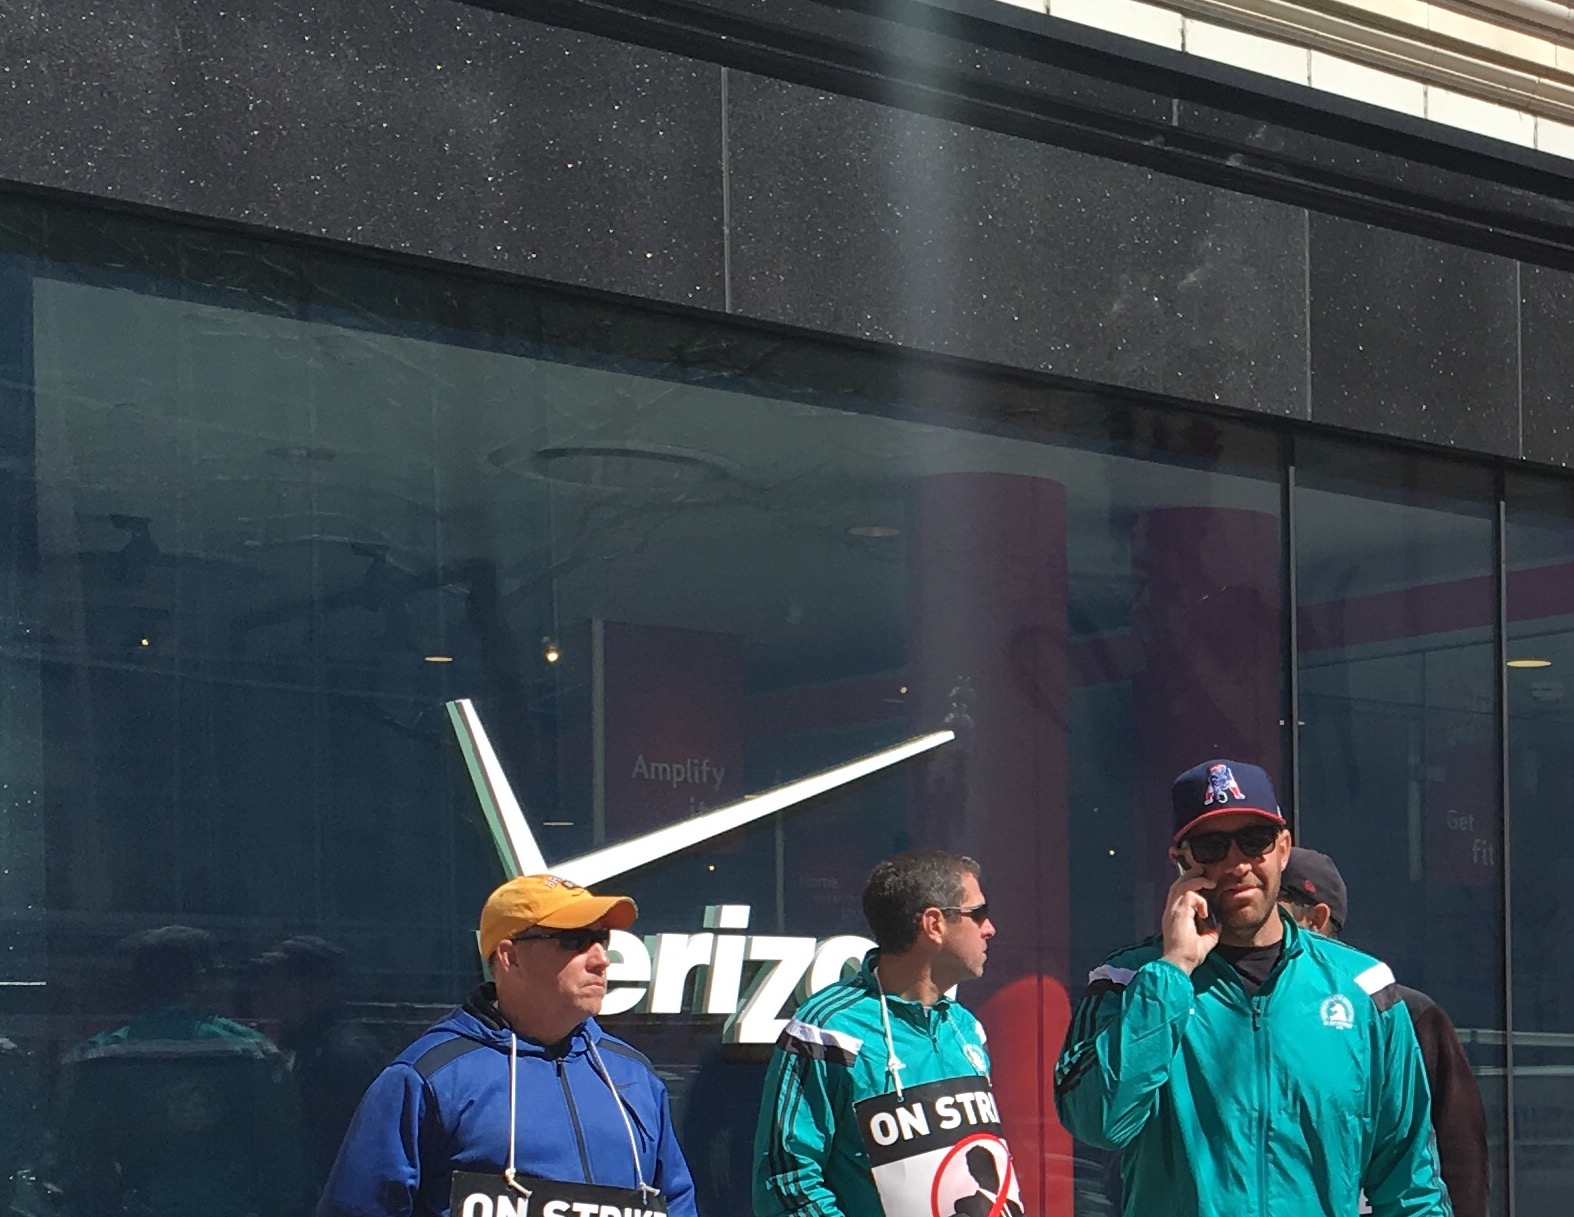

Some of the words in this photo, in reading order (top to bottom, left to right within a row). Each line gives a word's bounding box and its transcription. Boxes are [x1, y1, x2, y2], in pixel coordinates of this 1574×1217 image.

[631, 754, 726, 791] Amplify
[1446, 809, 1475, 831] Get
[1471, 838, 1495, 866] fit
[869, 1102, 931, 1147] ON
